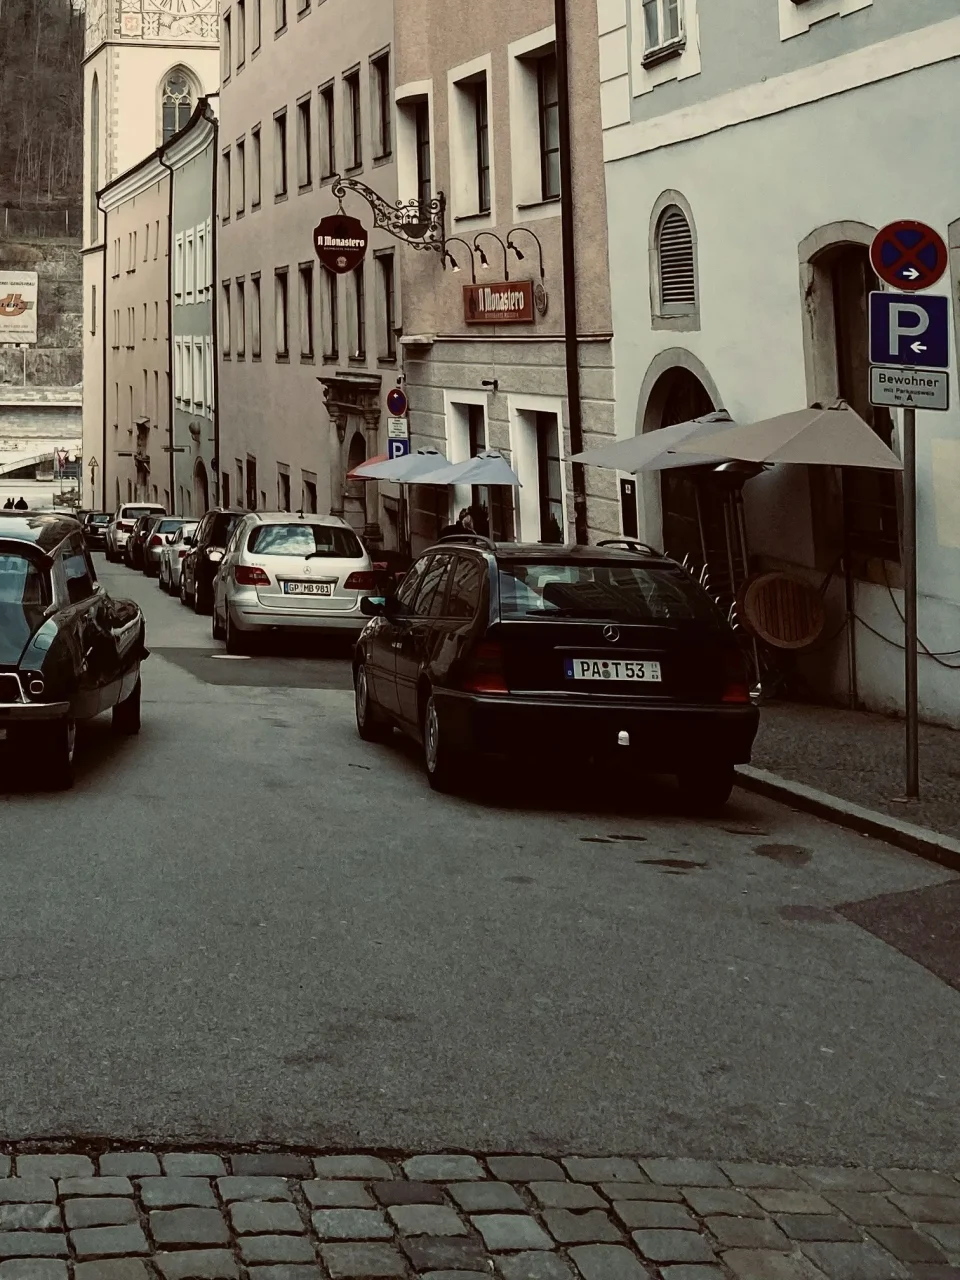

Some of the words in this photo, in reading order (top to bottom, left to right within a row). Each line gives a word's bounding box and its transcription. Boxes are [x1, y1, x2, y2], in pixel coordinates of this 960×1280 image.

[324, 235, 365, 247] Monastero
[484, 287, 524, 312] Monastero
[888, 302, 930, 356] P
[878, 373, 939, 388] Bewohner
[896, 387, 935, 396] Parkausweis
[906, 394, 914, 402] A
[393, 442, 404, 459] P
[580, 661, 601, 677] PA
[611, 662, 621, 678] T
[625, 662, 645, 679] 53
